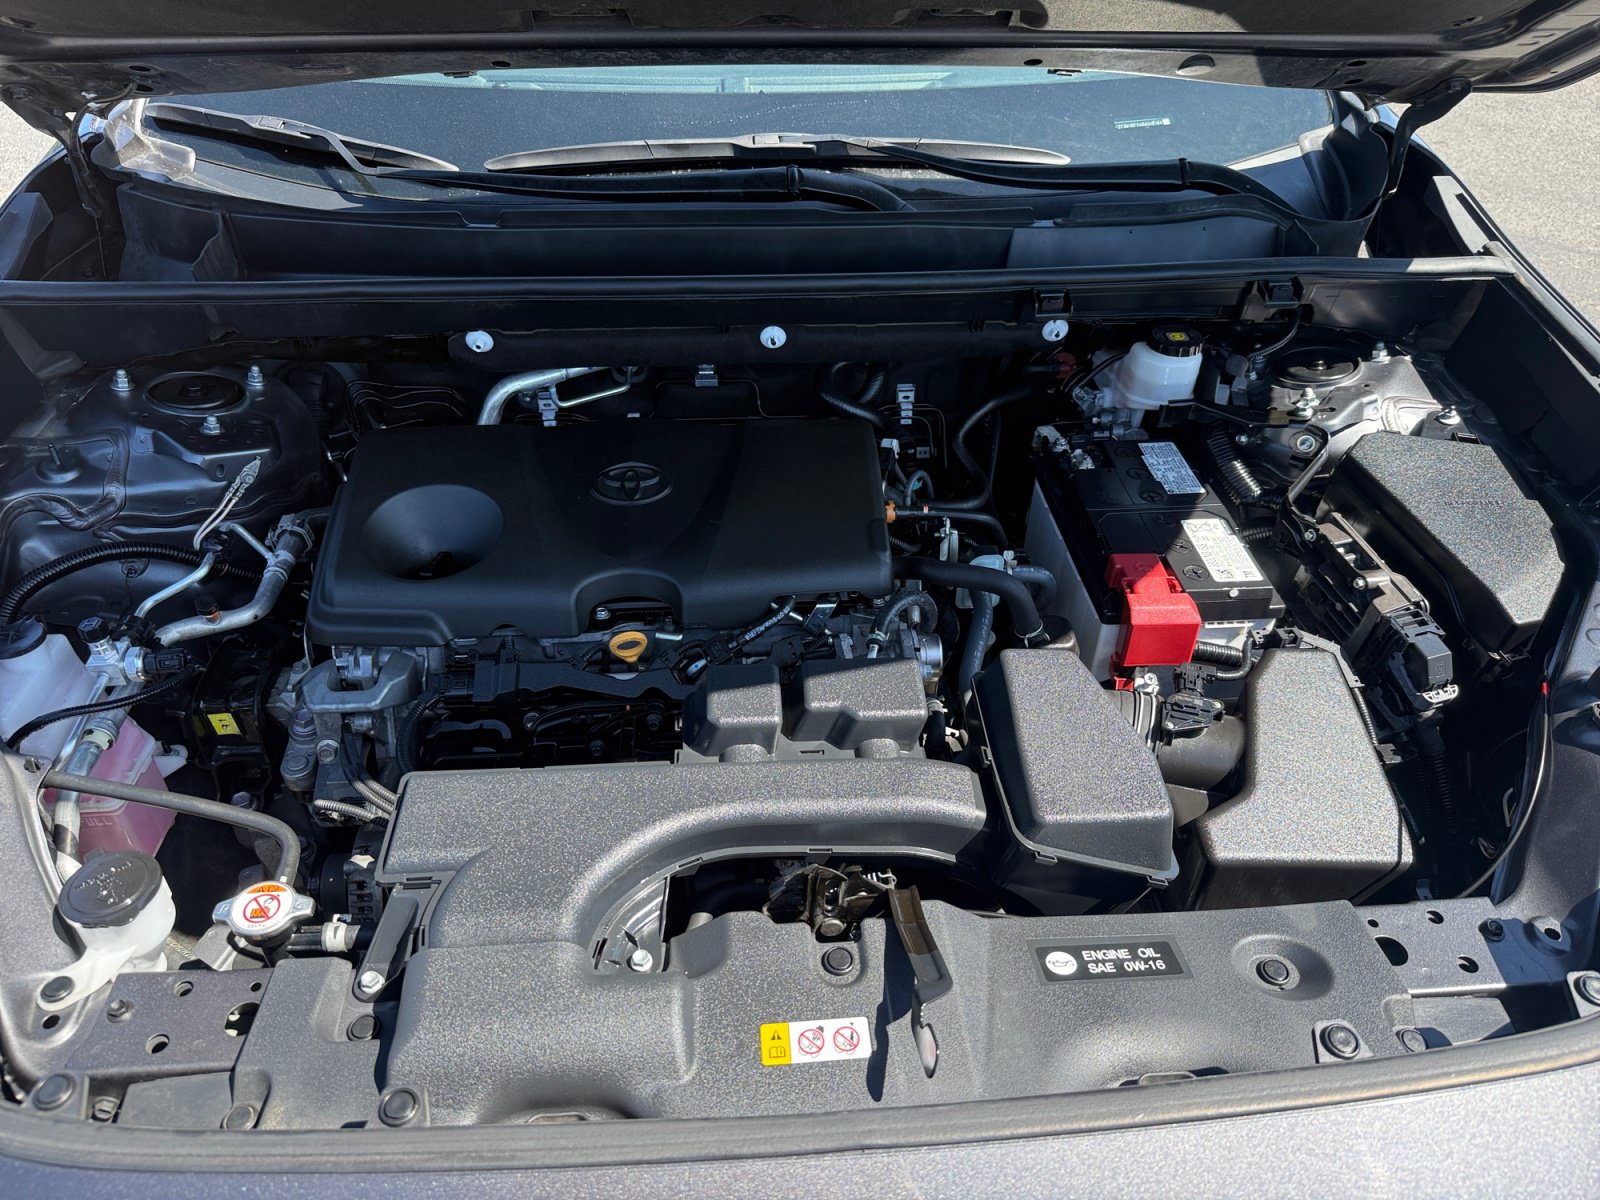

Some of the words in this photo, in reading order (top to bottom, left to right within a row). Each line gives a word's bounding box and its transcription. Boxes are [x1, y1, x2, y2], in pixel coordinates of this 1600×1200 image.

[1081, 948, 1131, 961] ENGINE
[1137, 946, 1160, 958] OIL
[1087, 961, 1117, 973] SAE
[1123, 959, 1166, 972] 0W-16
